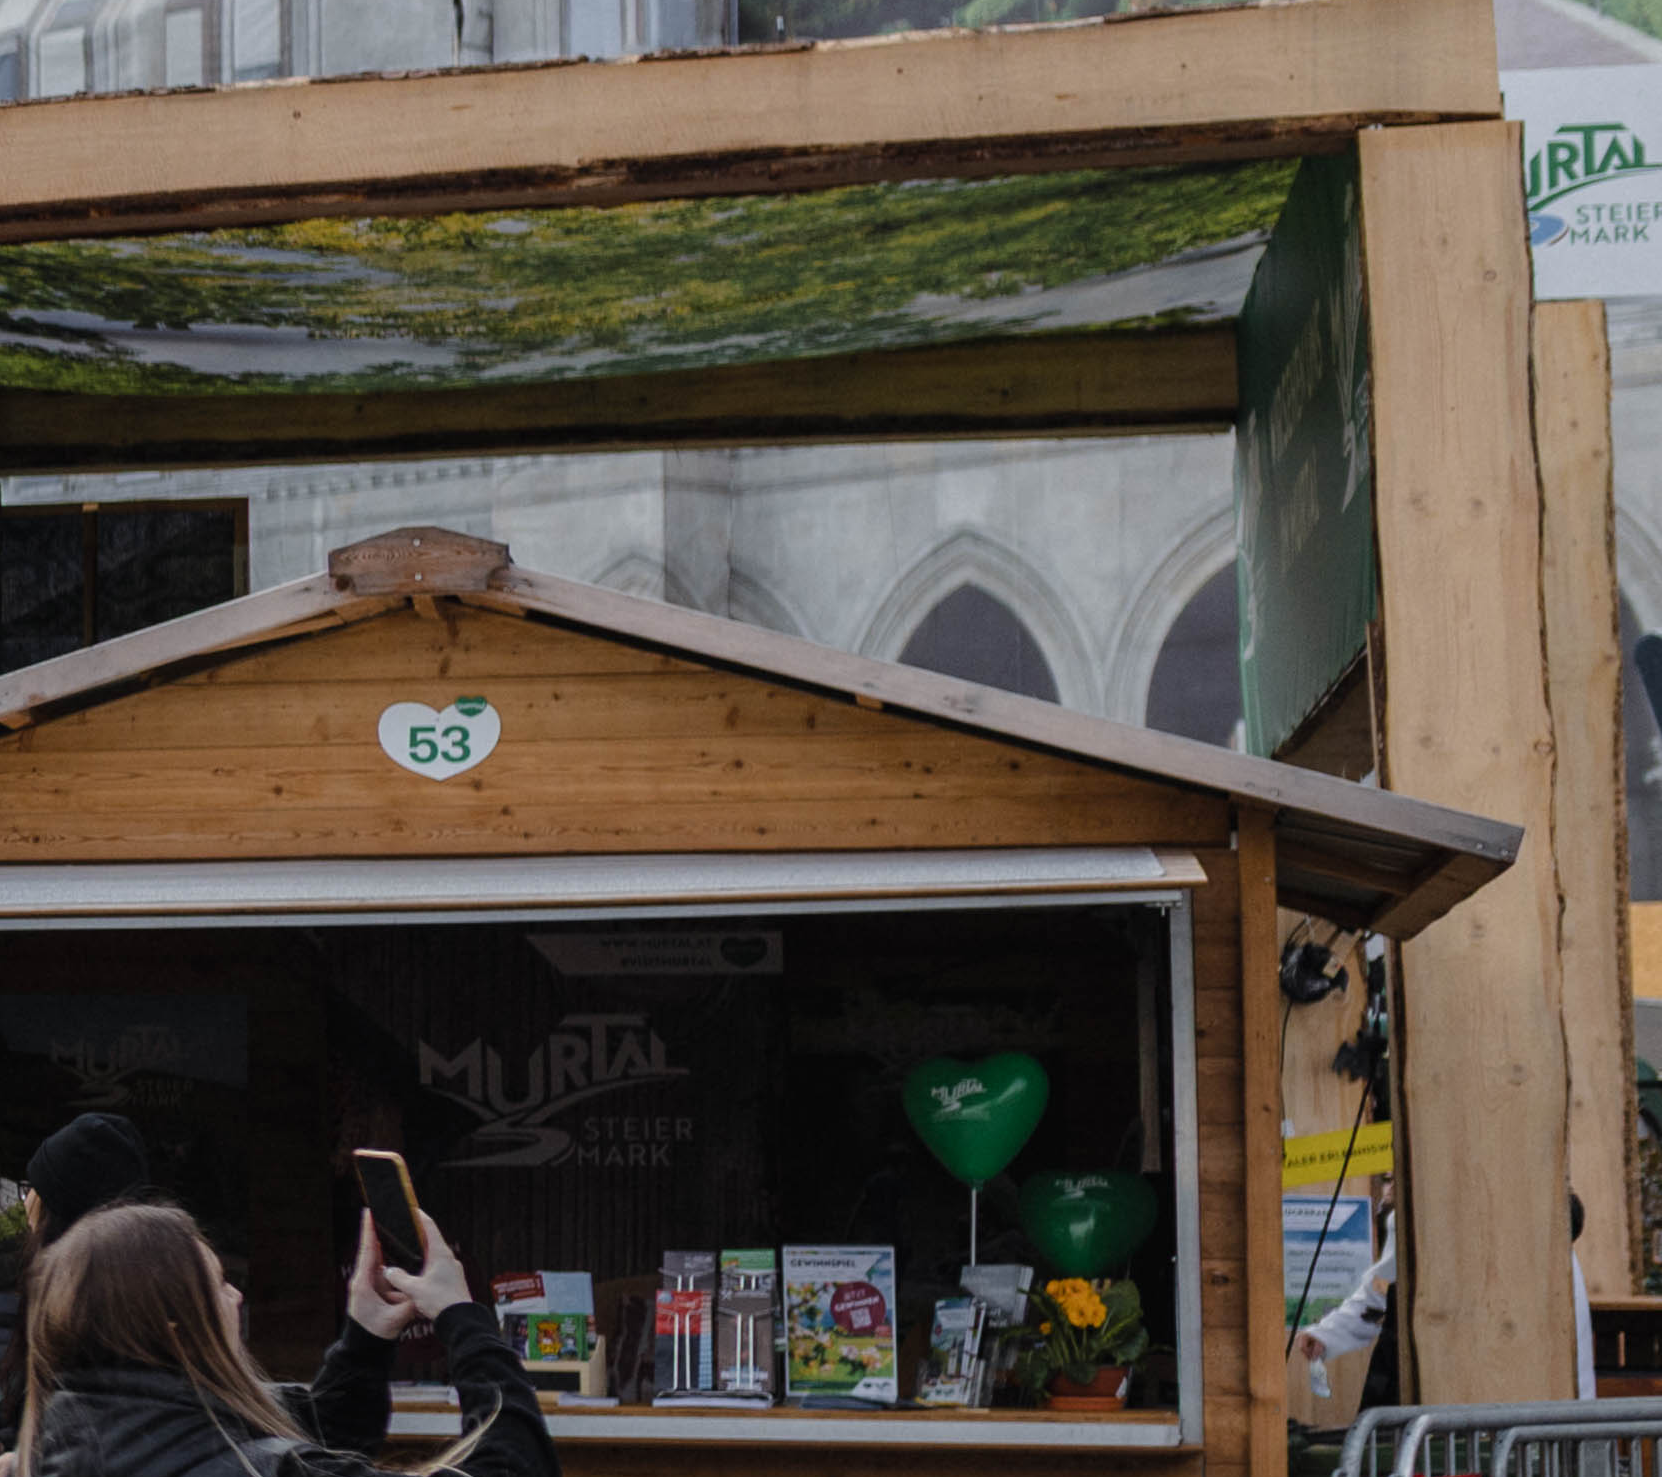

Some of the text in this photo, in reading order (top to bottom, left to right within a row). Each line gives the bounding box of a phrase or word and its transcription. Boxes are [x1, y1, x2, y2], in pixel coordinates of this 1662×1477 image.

[1569, 225, 1651, 246] MARK
[409, 726, 471, 763] 53
[418, 1013, 690, 1114] MURTAL
[583, 1116, 694, 1141] STEIER
[577, 1143, 671, 1167] MARK
[790, 1258, 857, 1268] GEWINNSPIEL
